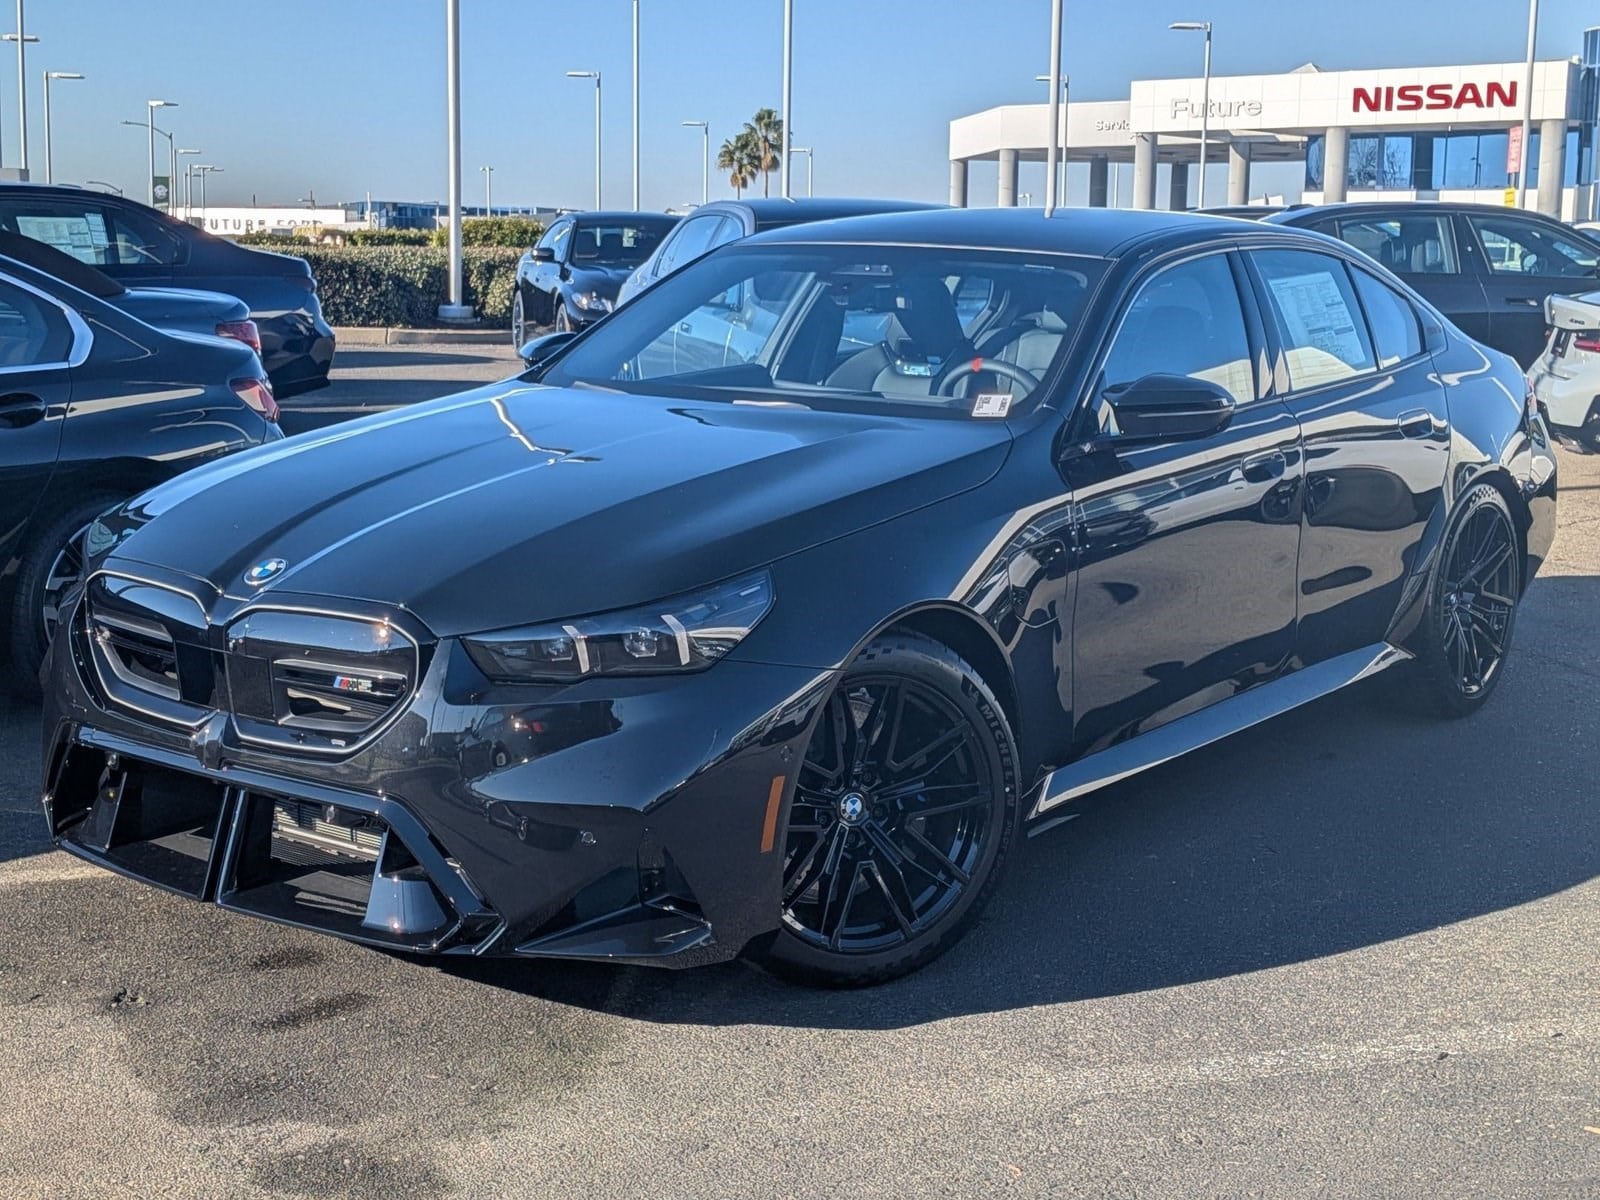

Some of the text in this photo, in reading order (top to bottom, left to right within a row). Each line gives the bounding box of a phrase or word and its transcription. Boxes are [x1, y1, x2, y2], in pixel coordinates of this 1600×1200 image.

[1352, 81, 1518, 113] NISSAN
[1171, 98, 1263, 119] Future
[1094, 119, 1131, 131] Servic
[203, 218, 265, 231] UTURE
